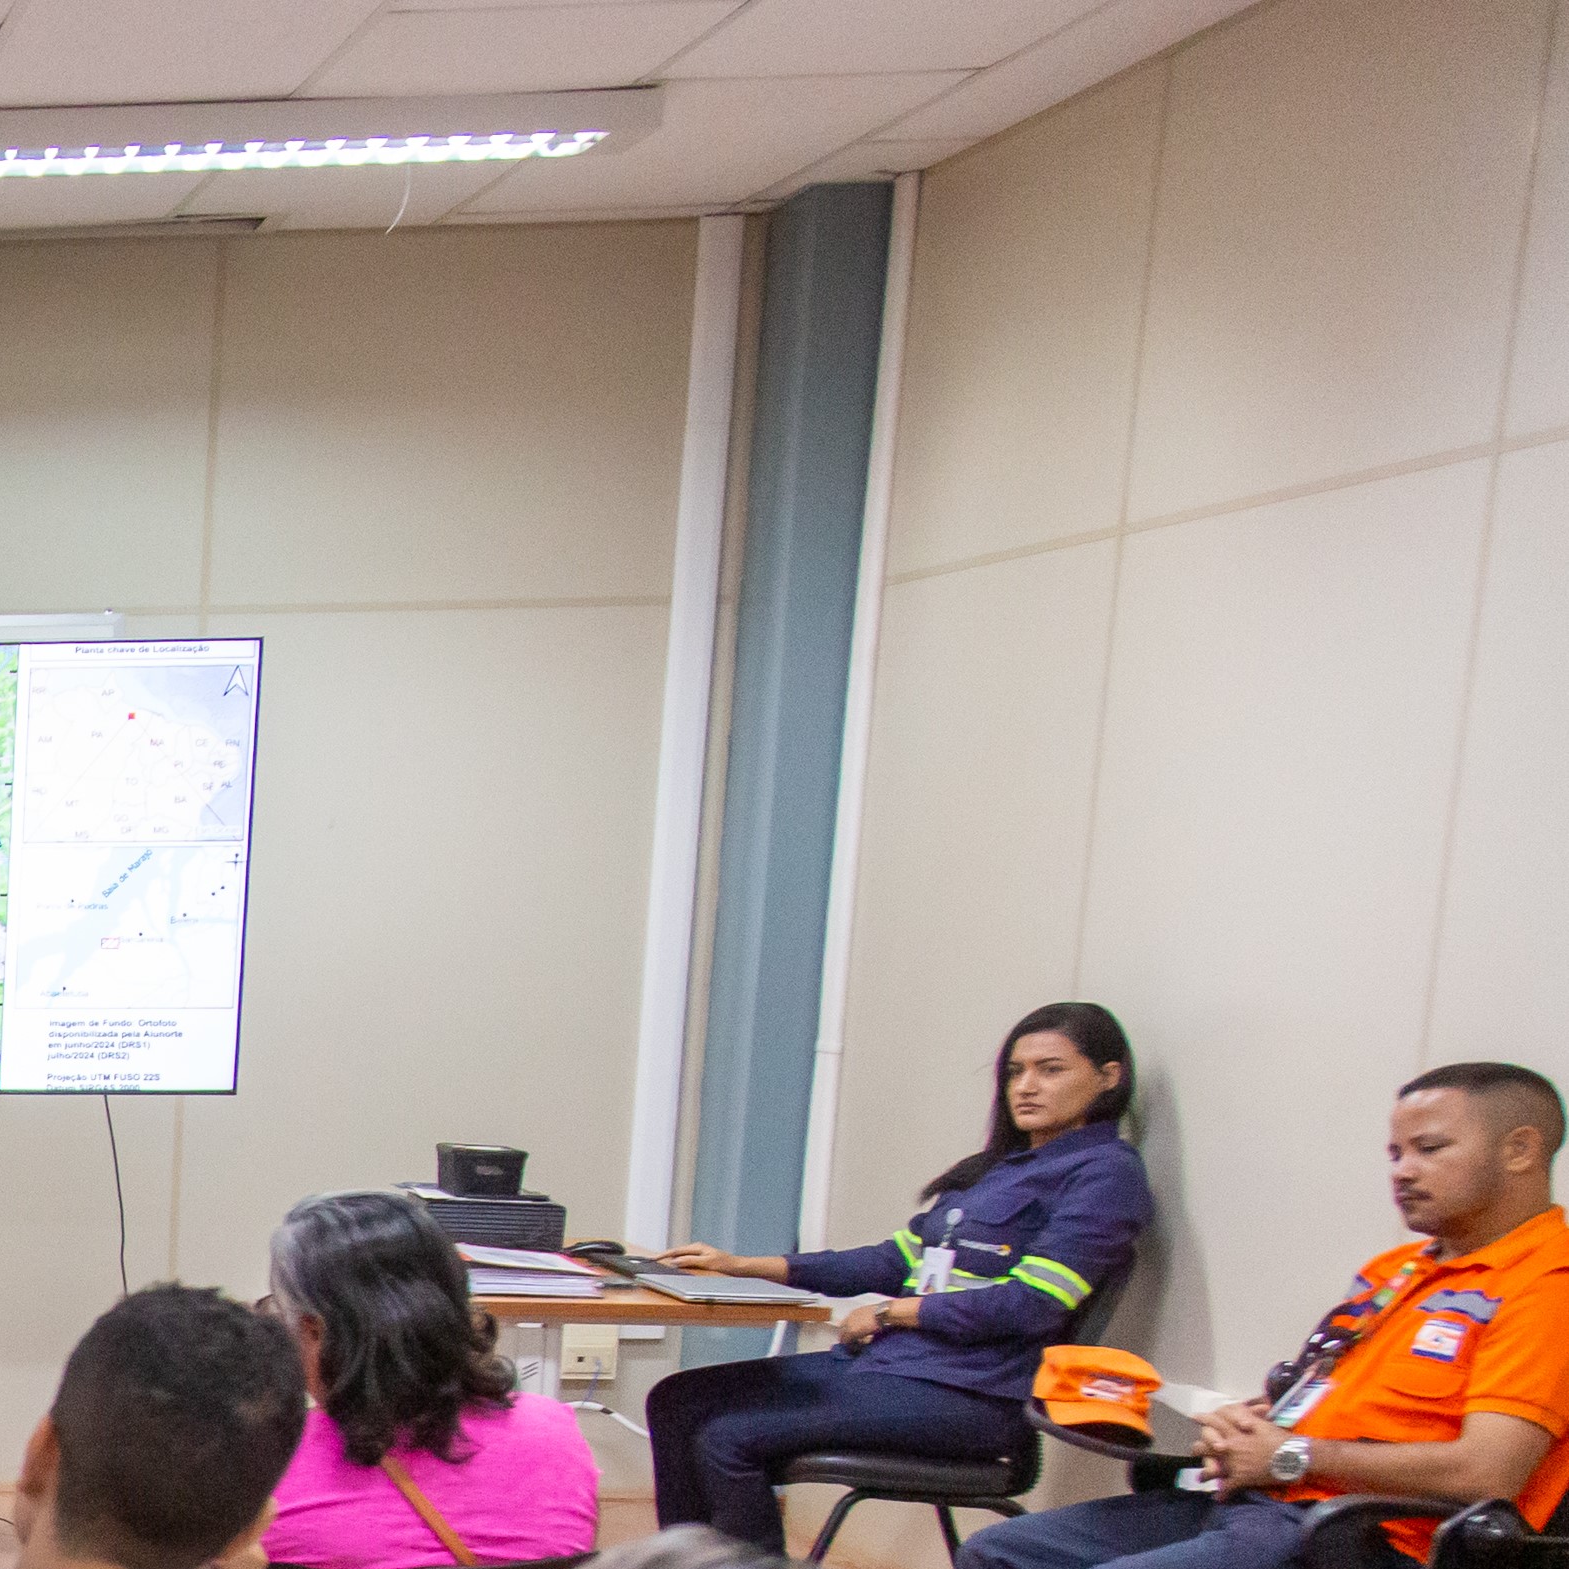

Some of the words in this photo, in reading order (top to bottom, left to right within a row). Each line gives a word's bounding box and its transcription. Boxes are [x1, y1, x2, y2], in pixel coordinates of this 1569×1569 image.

[153, 645, 209, 654] Localização
[49, 1031, 118, 1039] disponibilizada
[118, 1041, 151, 1049] (DRS1)
[47, 1052, 94, 1060] julho/2024
[97, 1052, 130, 1060] (DRS2)
[47, 1074, 87, 1082] Projeção
